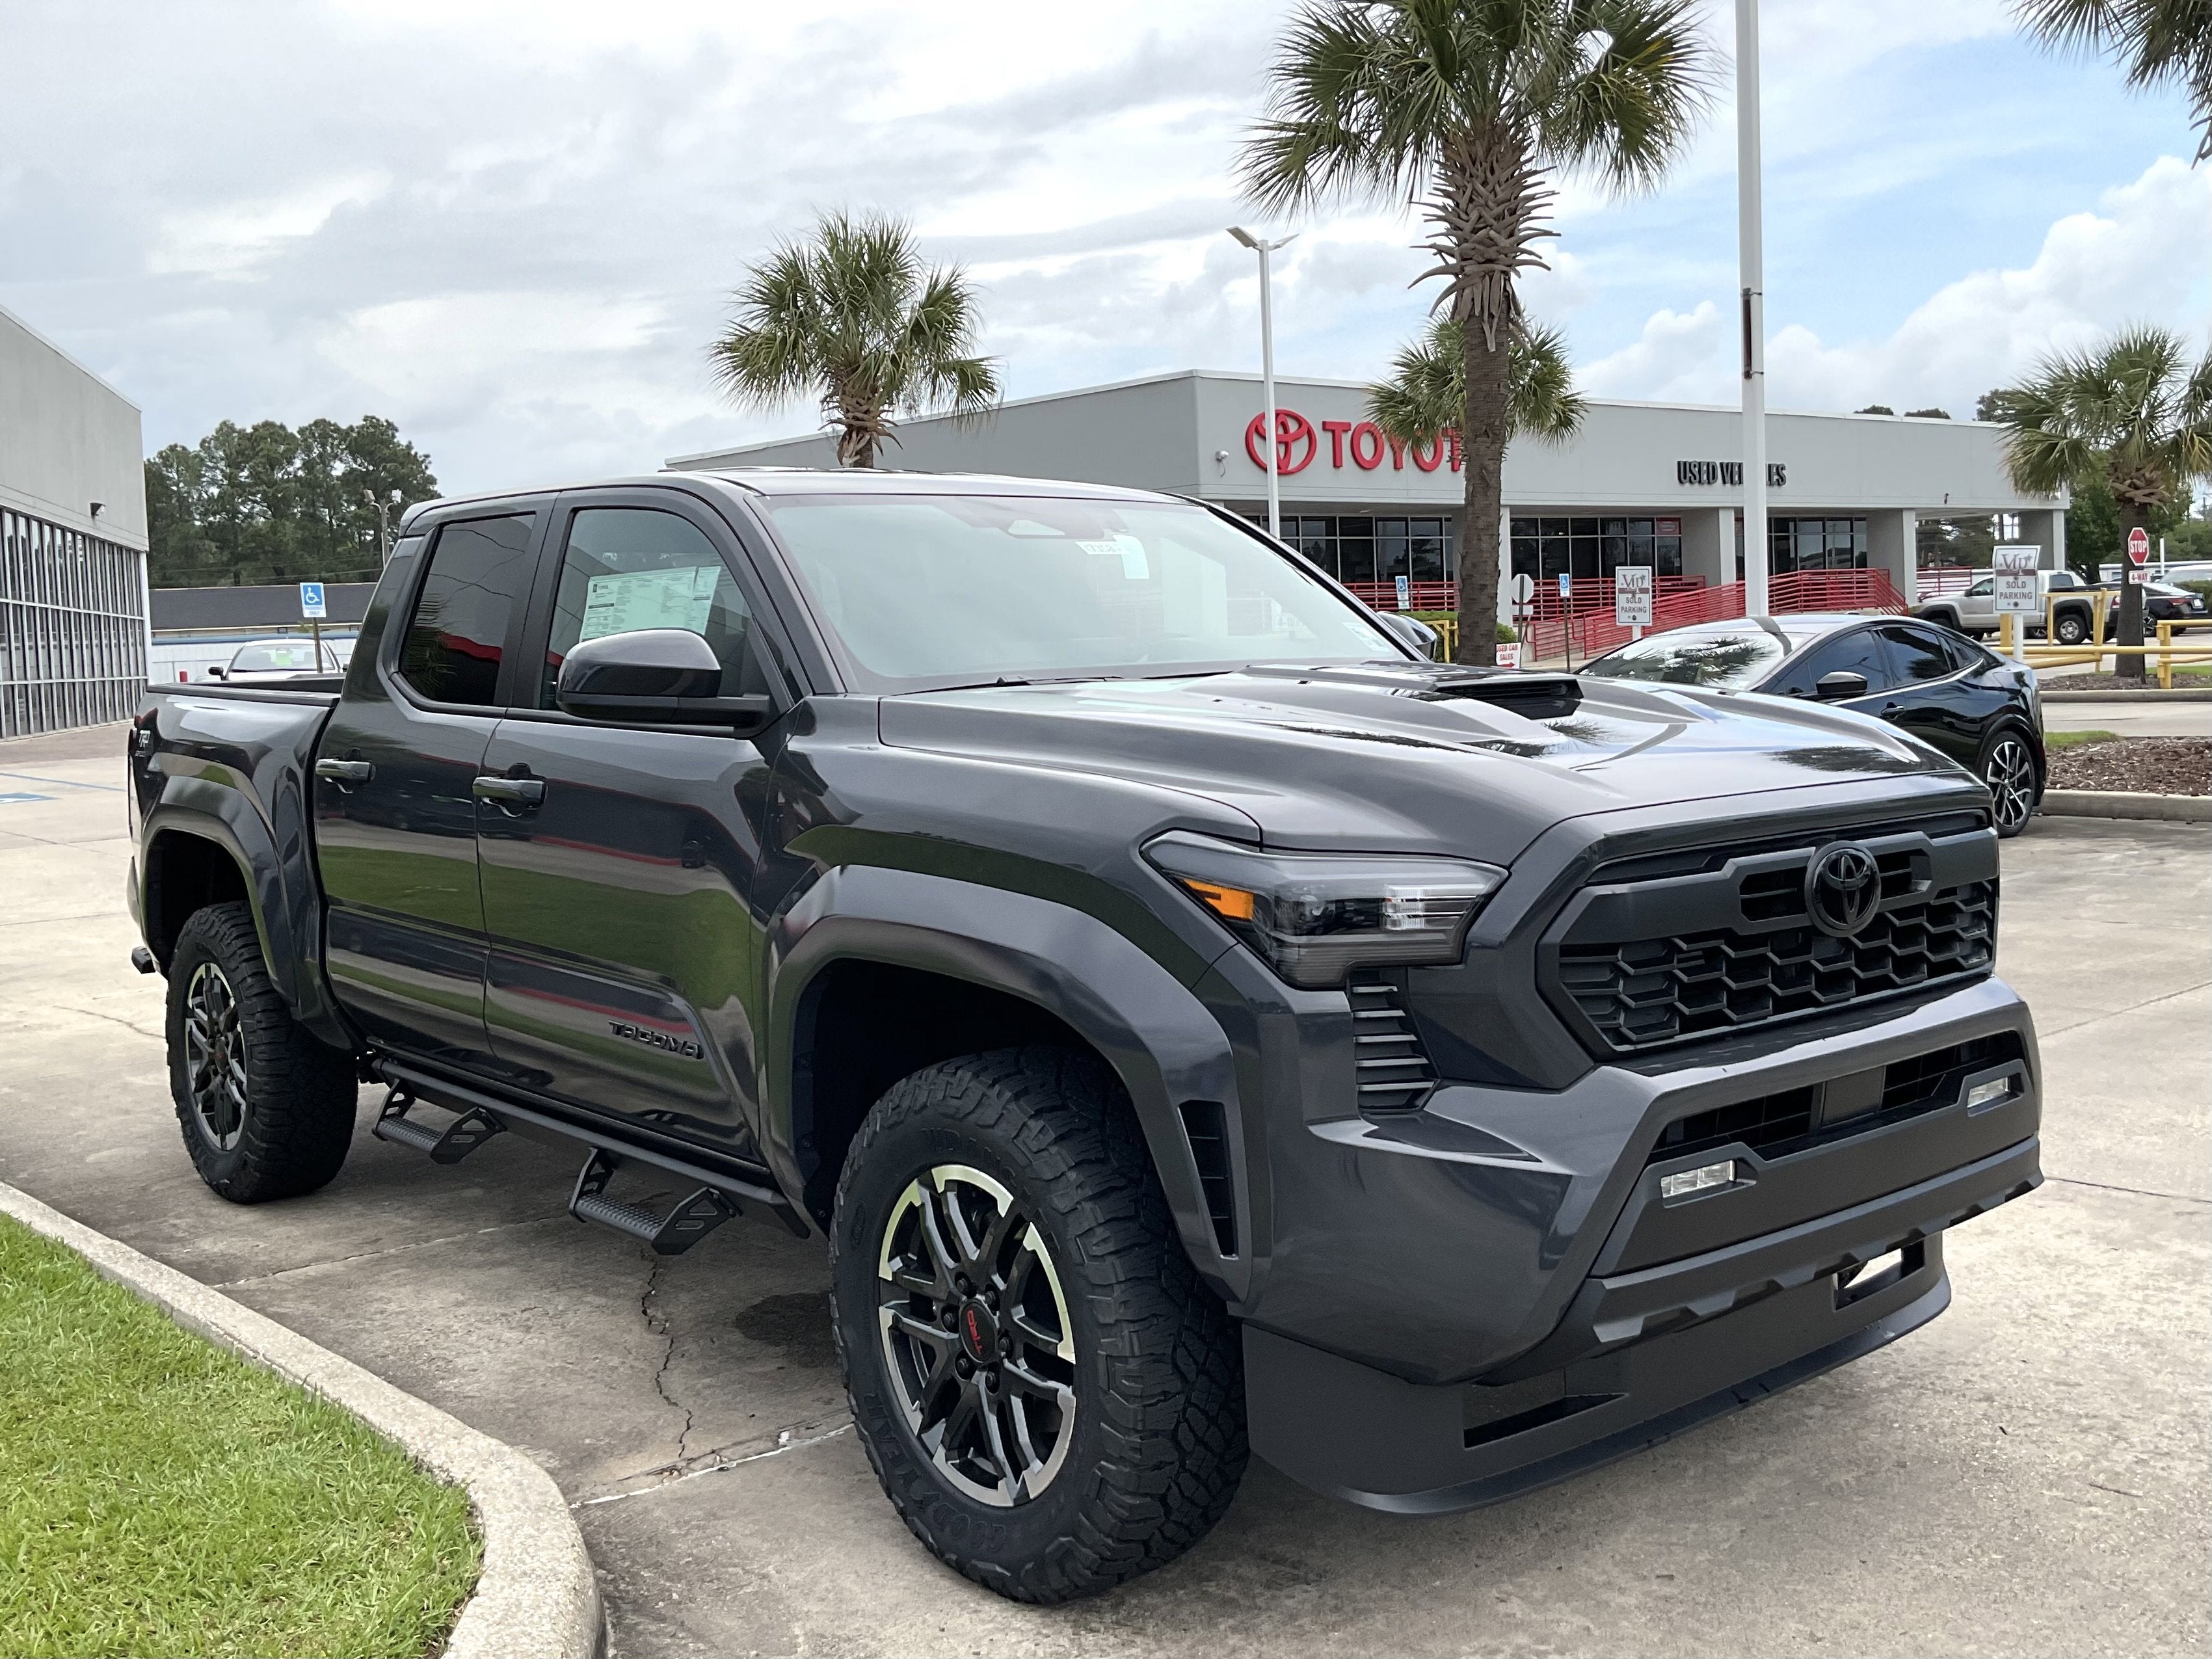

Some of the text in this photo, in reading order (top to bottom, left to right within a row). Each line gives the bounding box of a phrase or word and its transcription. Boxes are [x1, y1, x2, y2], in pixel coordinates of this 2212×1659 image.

[1322, 421, 1463, 472] TOYOT
[1677, 460, 1718, 485] USED
[2130, 540, 2146, 553] STOP
[2131, 573, 2148, 581] 4-WAY
[1999, 591, 2032, 600] PARKING
[608, 1020, 704, 1060] TACOMA
